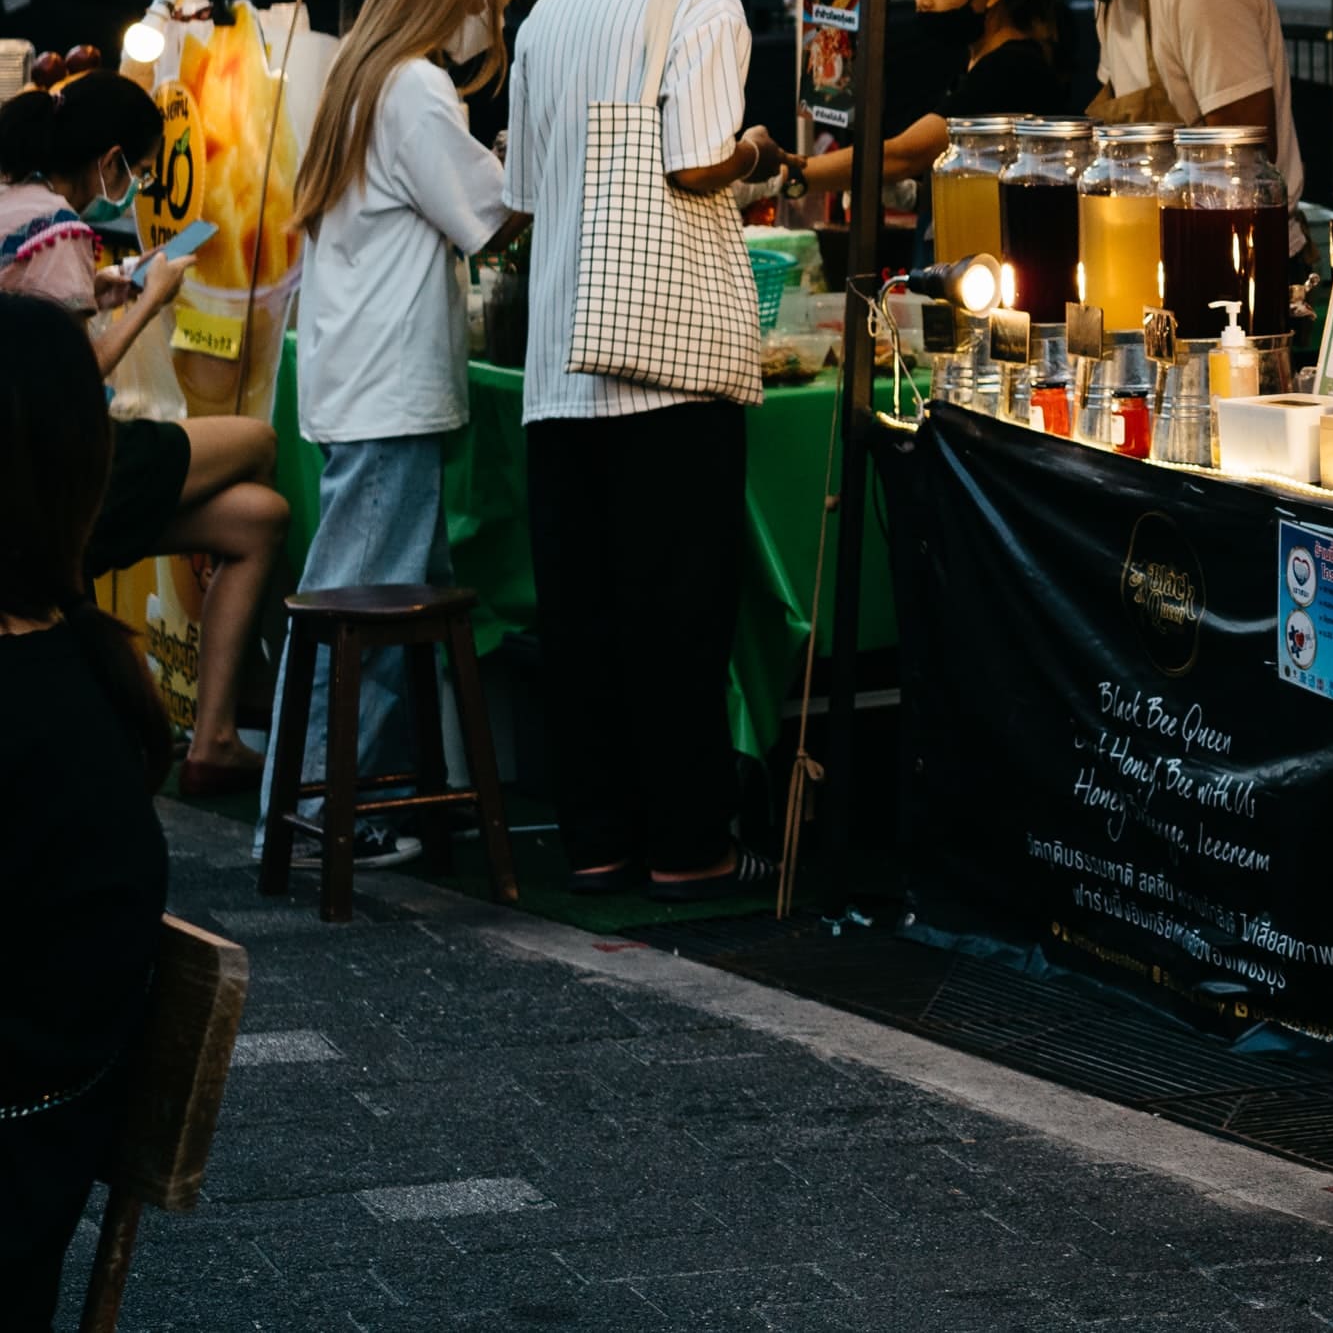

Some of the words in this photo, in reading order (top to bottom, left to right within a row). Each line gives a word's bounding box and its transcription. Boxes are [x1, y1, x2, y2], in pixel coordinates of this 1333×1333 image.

[1098, 681, 1143, 728] Black
[1147, 696, 1177, 738] Bee
[1182, 703, 1233, 754] Queen
[1166, 758, 1193, 800] Bee
[1198, 773, 1233, 813] with
[1233, 779, 1257, 818] Us
[1199, 822, 1272, 872] Icecream
